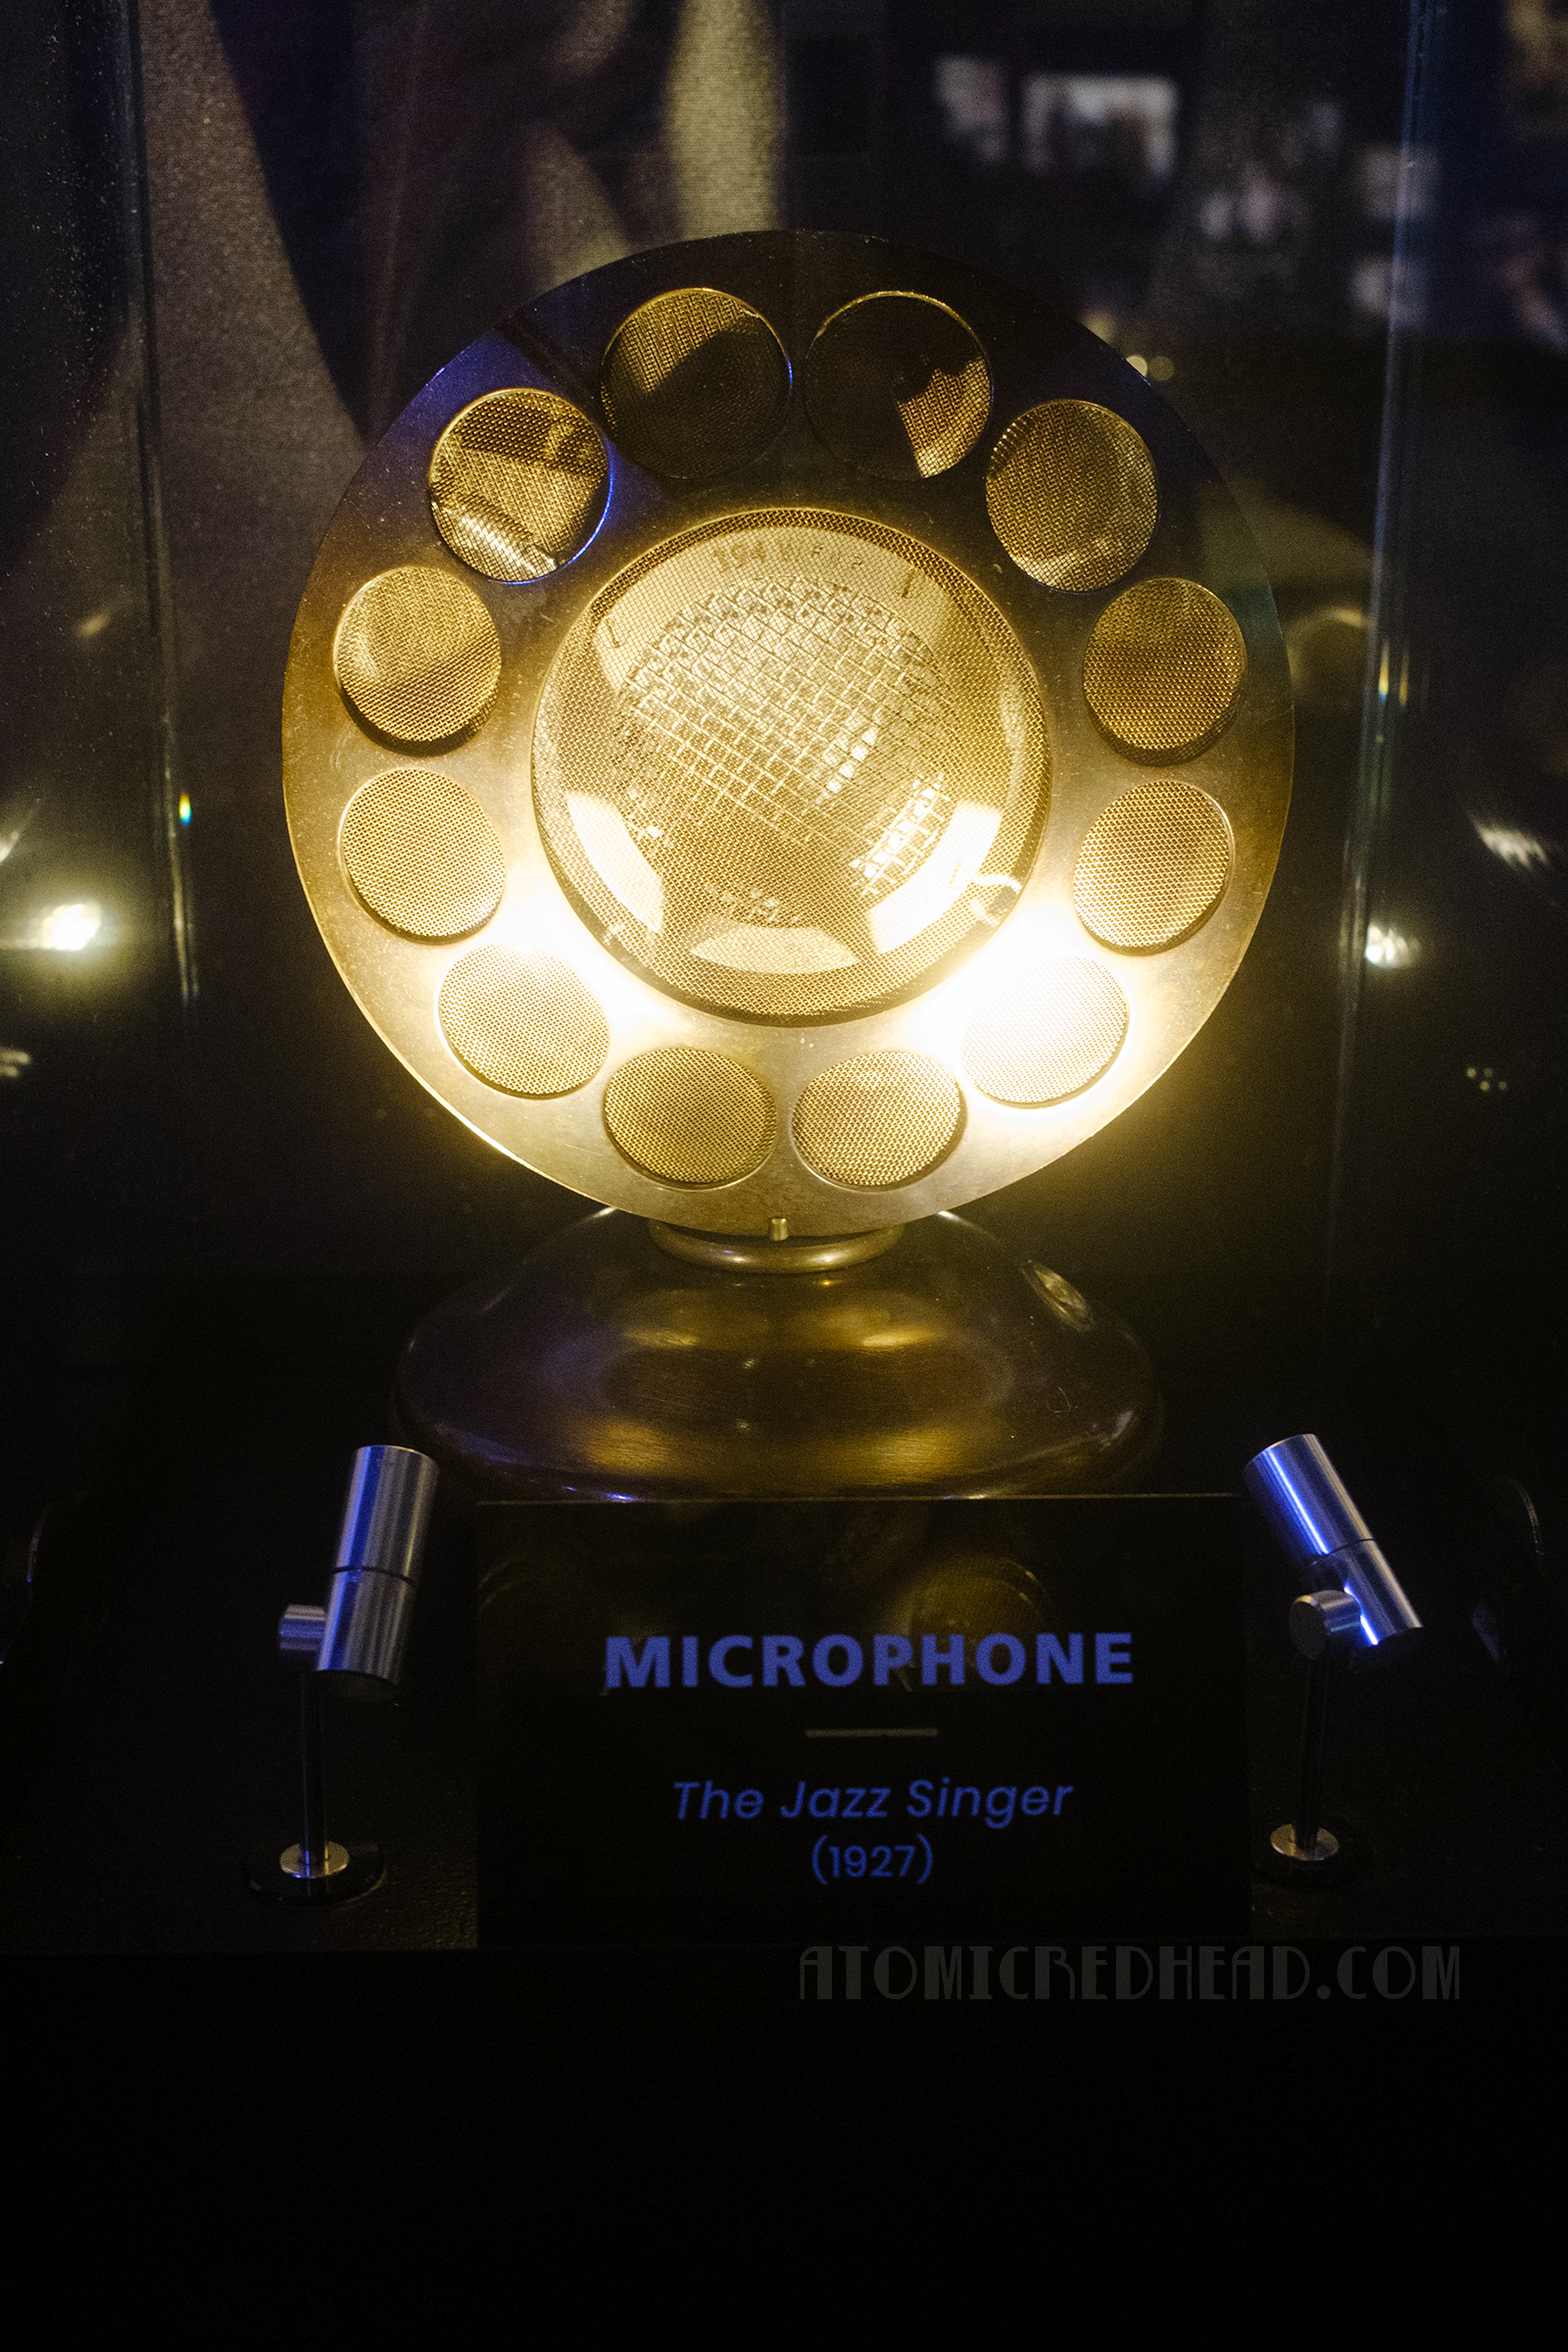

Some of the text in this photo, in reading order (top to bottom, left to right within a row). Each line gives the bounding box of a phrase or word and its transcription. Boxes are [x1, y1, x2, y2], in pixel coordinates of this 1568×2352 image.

[605, 1633, 1133, 1688] MICROPHONE
[674, 1777, 1074, 1830] The Jazz Singer
[811, 1835, 933, 1886] (1927)
